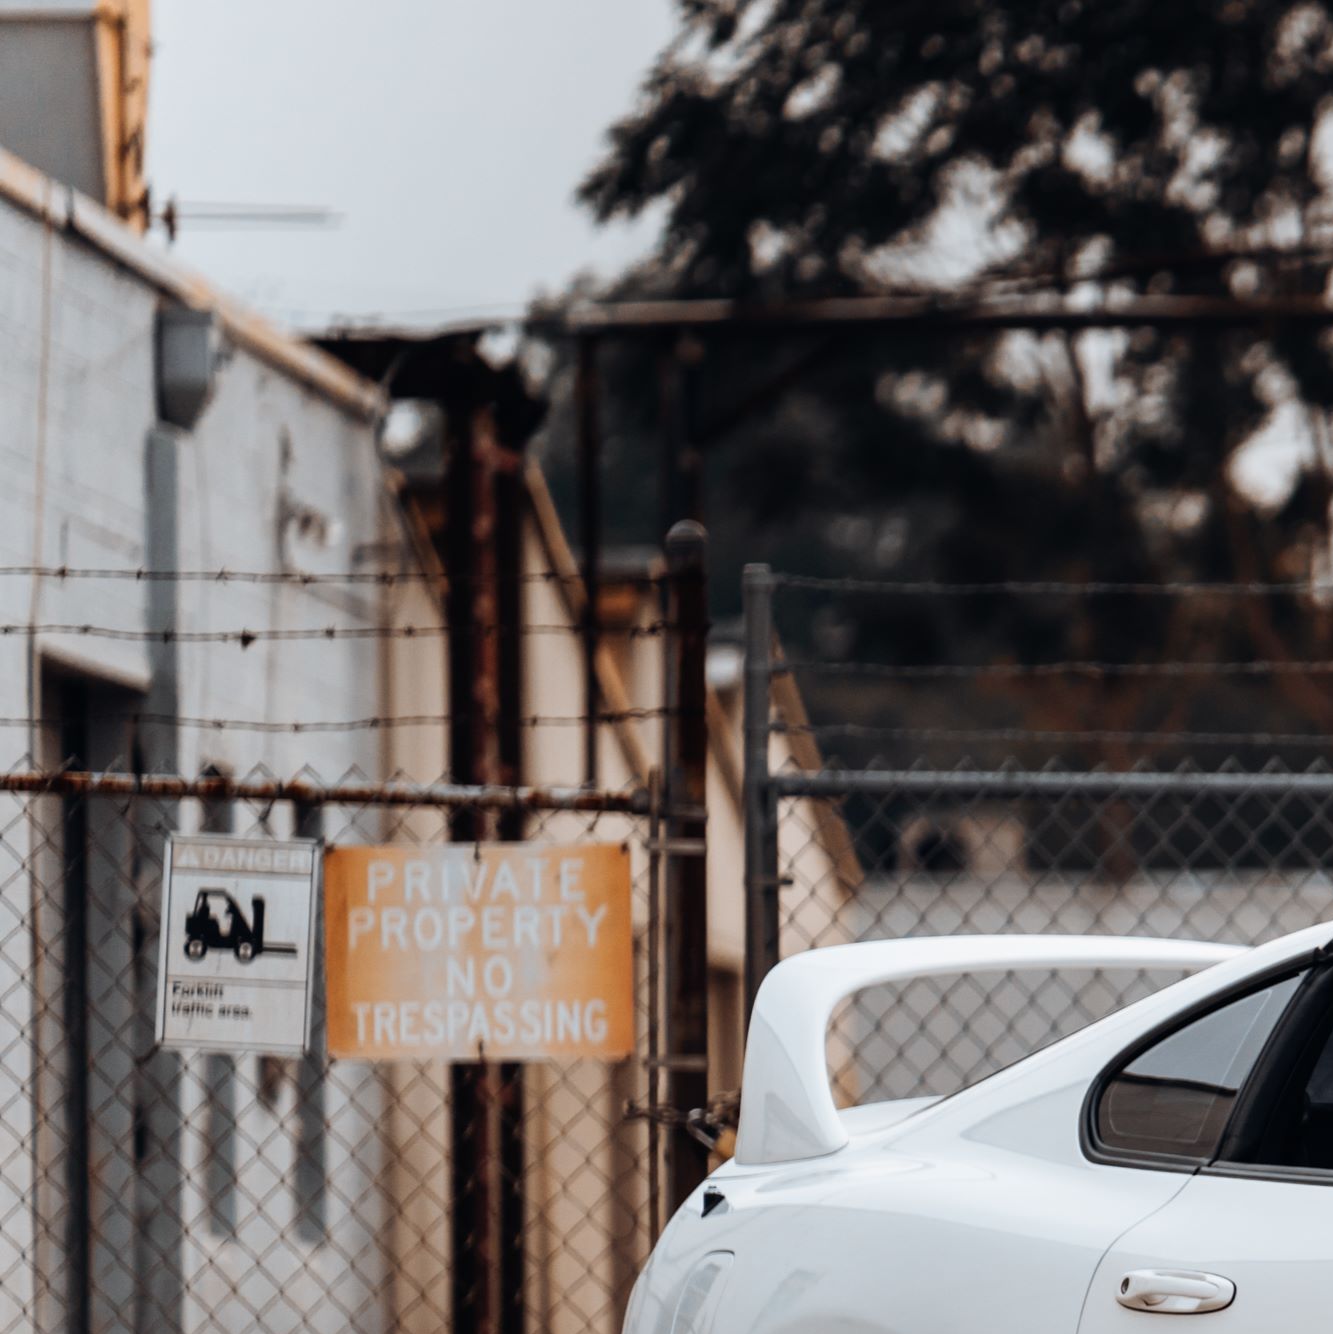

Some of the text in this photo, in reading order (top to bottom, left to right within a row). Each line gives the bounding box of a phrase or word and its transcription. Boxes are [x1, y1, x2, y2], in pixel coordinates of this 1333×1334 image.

[203, 847, 310, 873] DANGER
[367, 857, 587, 902] PRIVATE
[348, 904, 607, 951] PROPERTY
[172, 981, 224, 999] Forklift
[447, 955, 513, 998] NO
[171, 1001, 214, 1018] traffic
[352, 998, 608, 1045] TRESPASSING
